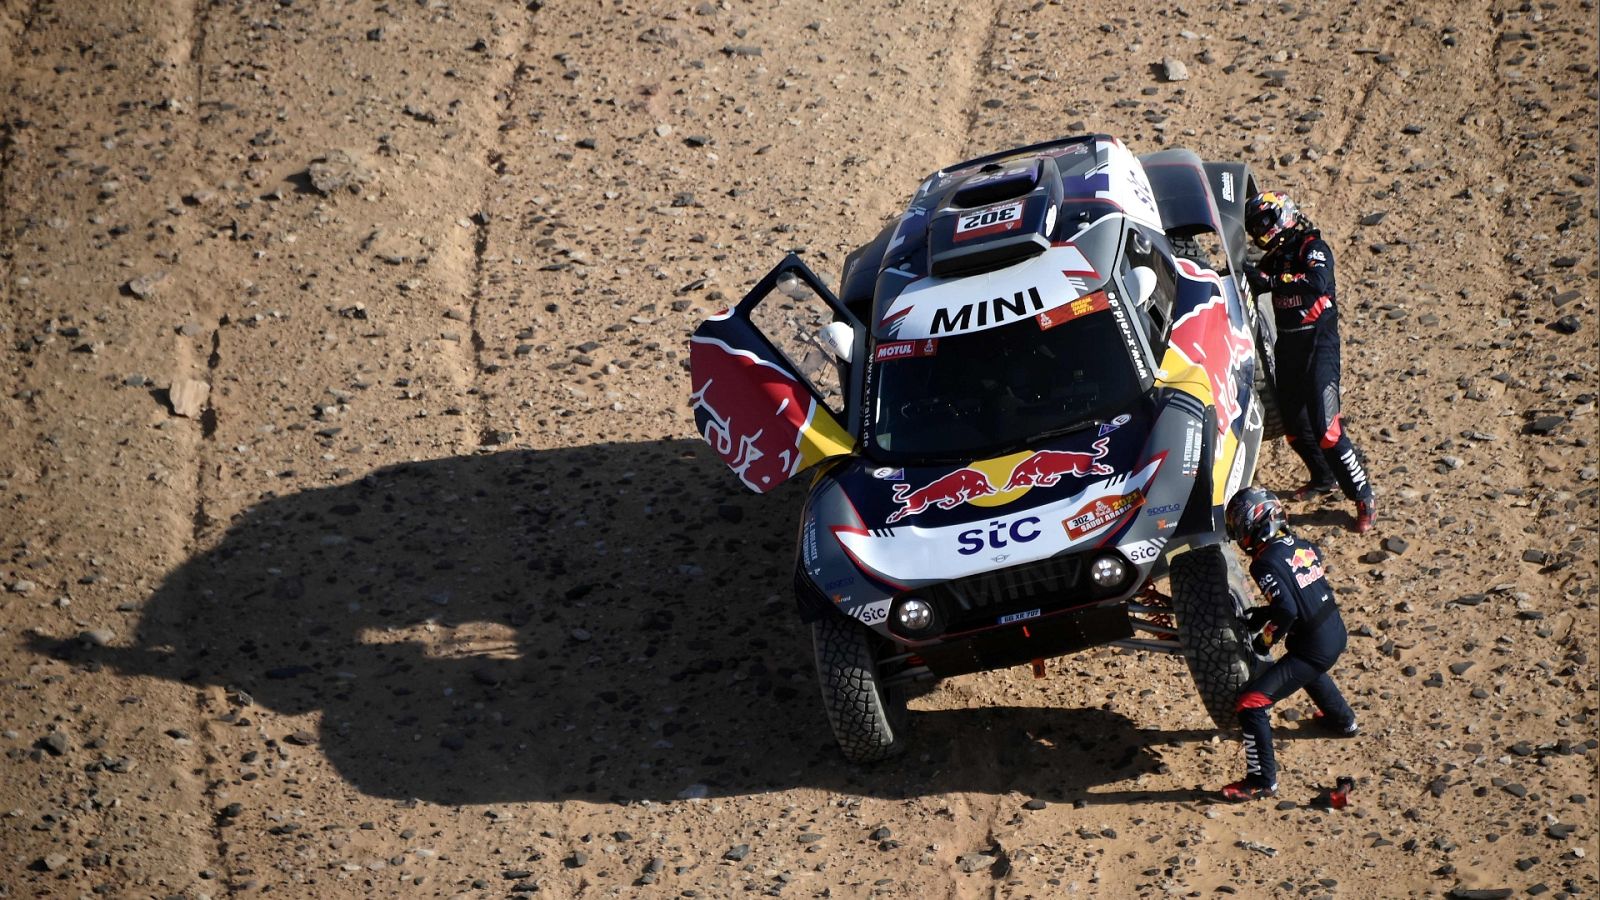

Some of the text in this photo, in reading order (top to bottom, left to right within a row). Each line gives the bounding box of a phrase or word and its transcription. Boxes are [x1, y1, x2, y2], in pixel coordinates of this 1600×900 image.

[964, 207, 1015, 229] 302
[930, 286, 1044, 335] MINI
[1107, 292, 1148, 379] www.x-raid.de
[878, 344, 911, 358] MOTUL
[1340, 449, 1367, 491] MINI
[1073, 514, 1090, 527] 302
[1081, 504, 1132, 532] SAUDI ARABIA
[1146, 504, 1180, 516] sparco
[957, 516, 1041, 556] stc
[1131, 545, 1156, 561] stc
[863, 607, 886, 622] stc
[1243, 733, 1262, 775] MINI
